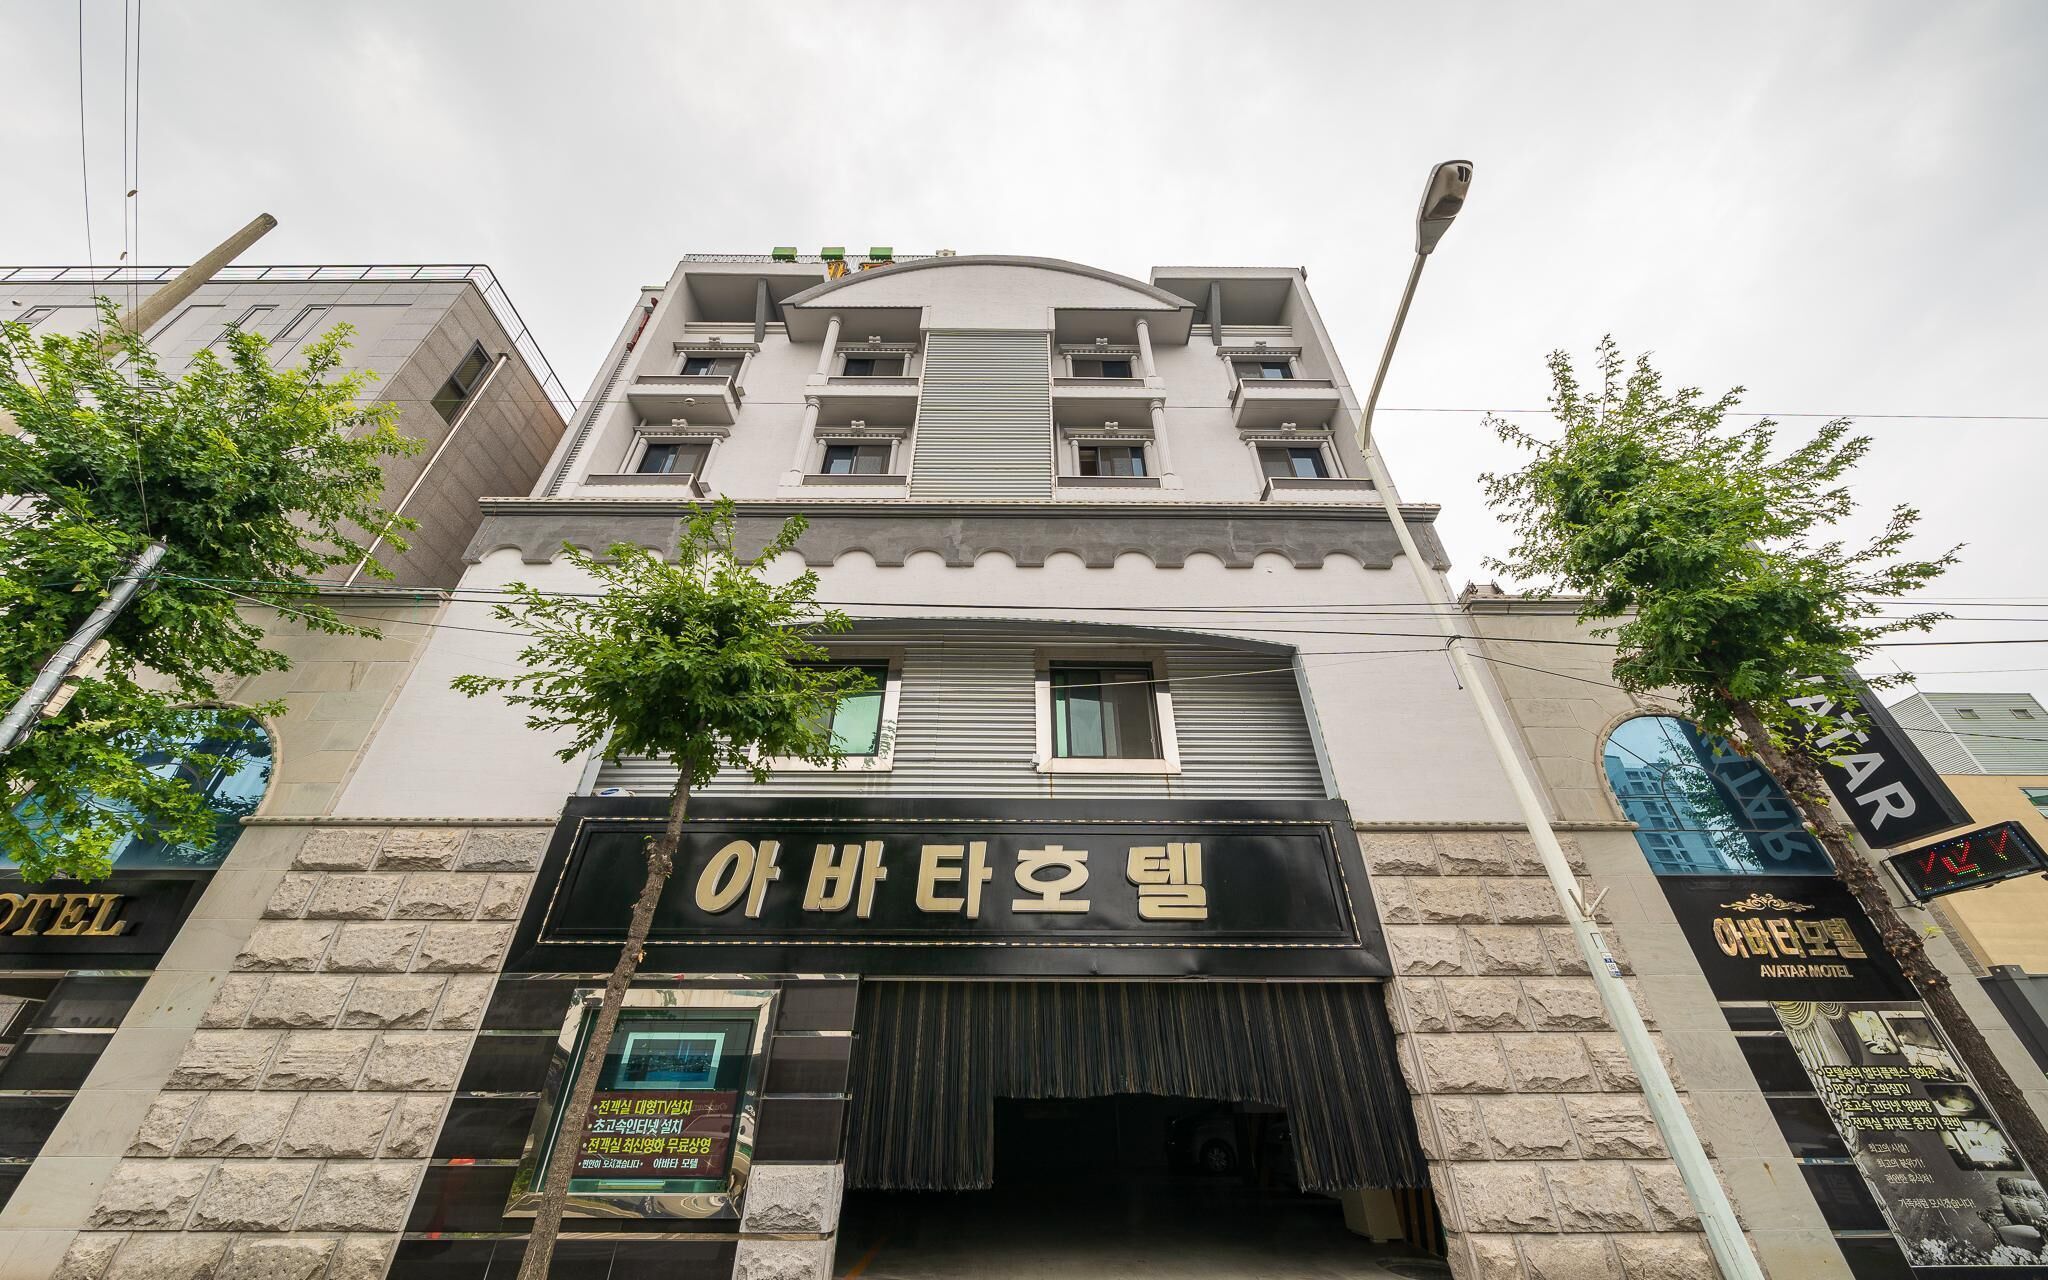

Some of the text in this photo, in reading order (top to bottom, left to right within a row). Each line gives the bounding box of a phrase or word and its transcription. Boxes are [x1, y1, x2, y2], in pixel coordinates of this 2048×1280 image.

[1786, 673, 1917, 832] ATAR
[694, 838, 1208, 921] 아바타호텔
[1712, 916, 1868, 959] 아바타모텔
[1760, 964, 1854, 978] AVATAR MOTEL
[1863, 1066, 1910, 1079] 멀티플렉스
[1909, 1066, 1940, 1079] 영화관
[1832, 1083, 1853, 1096] PDP
[1872, 1083, 1911, 1096] 고화질TV
[598, 1100, 631, 1115] 전객실
[634, 1100, 693, 1115] 대형TV설치
[1843, 1100, 1933, 1113] 초고속 인터넷 영화방
[592, 1119, 683, 1135] 초고속인터넷 설치
[1852, 1117, 1966, 1131] 전객실 휴대폰 충전기 완비
[587, 1137, 711, 1154] 전객실 최신영화 무료상영
[1869, 1143, 1891, 1153] 최고의
[653, 1159, 678, 1169] 아바타
[680, 1159, 698, 1169] 모텔
[1877, 1158, 1900, 1168] 최고의
